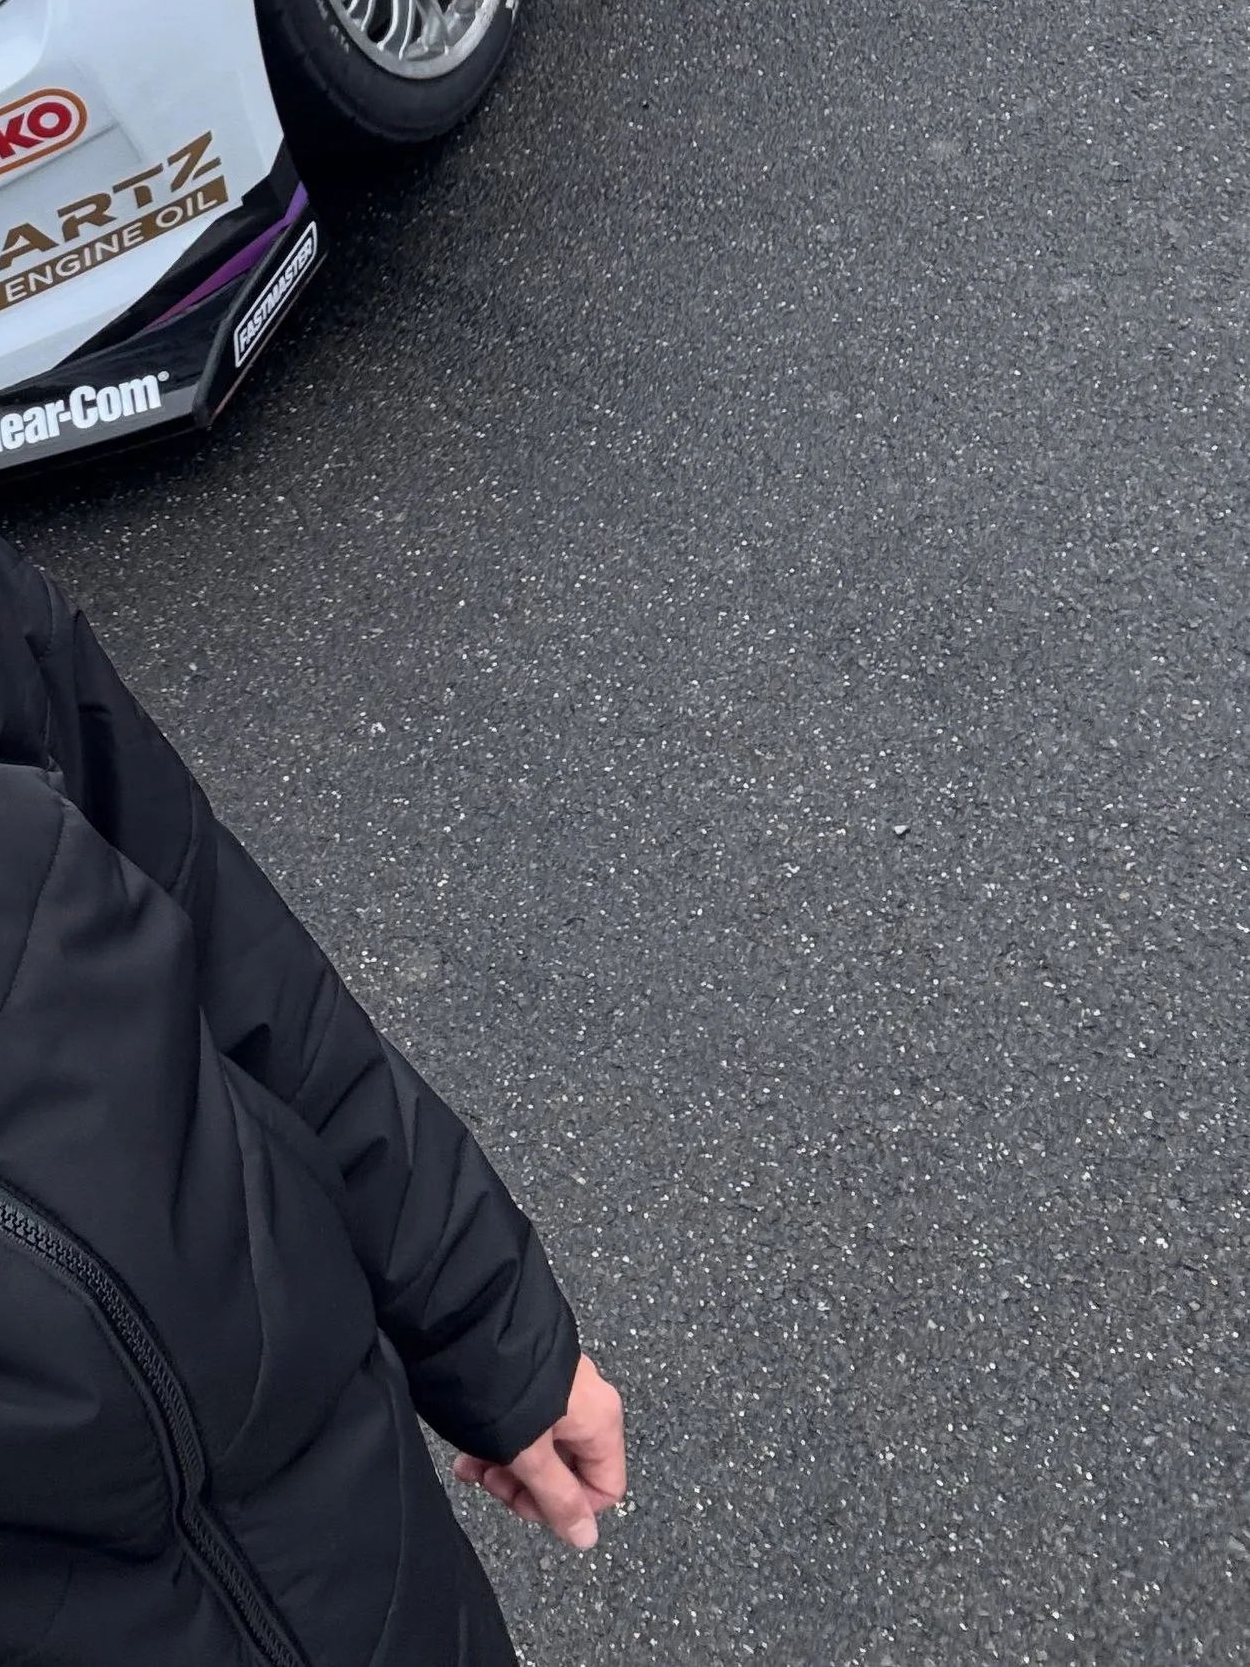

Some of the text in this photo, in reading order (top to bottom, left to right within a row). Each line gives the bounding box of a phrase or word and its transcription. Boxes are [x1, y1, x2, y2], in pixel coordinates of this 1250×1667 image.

[4, 191, 219, 304] ENGINE OIL
[240, 236, 313, 353] FASTMASTER
